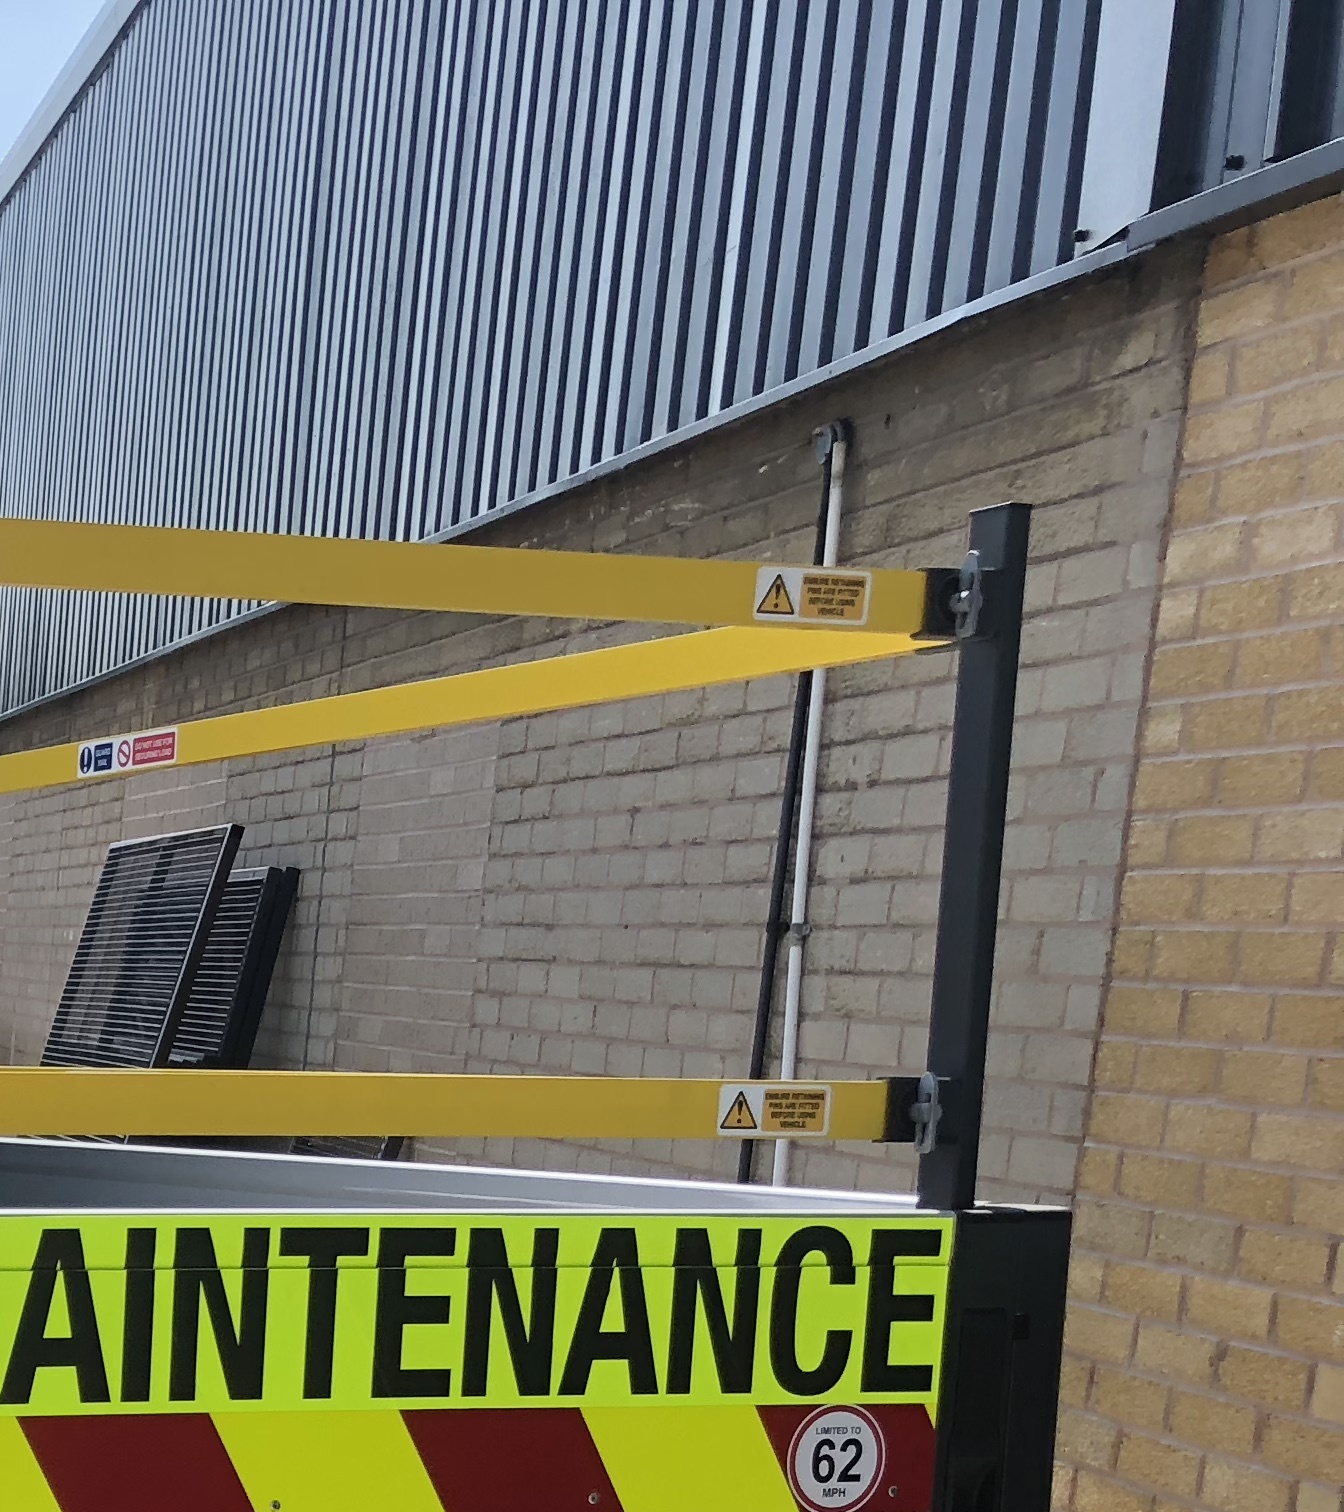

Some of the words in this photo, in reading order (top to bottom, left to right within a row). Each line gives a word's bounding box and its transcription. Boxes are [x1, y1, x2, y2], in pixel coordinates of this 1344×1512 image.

[815, 1426, 849, 1435] LIMITED
[850, 1426, 862, 1435] TO
[812, 1437, 863, 1484] 62
[822, 1488, 846, 1498] MPH
